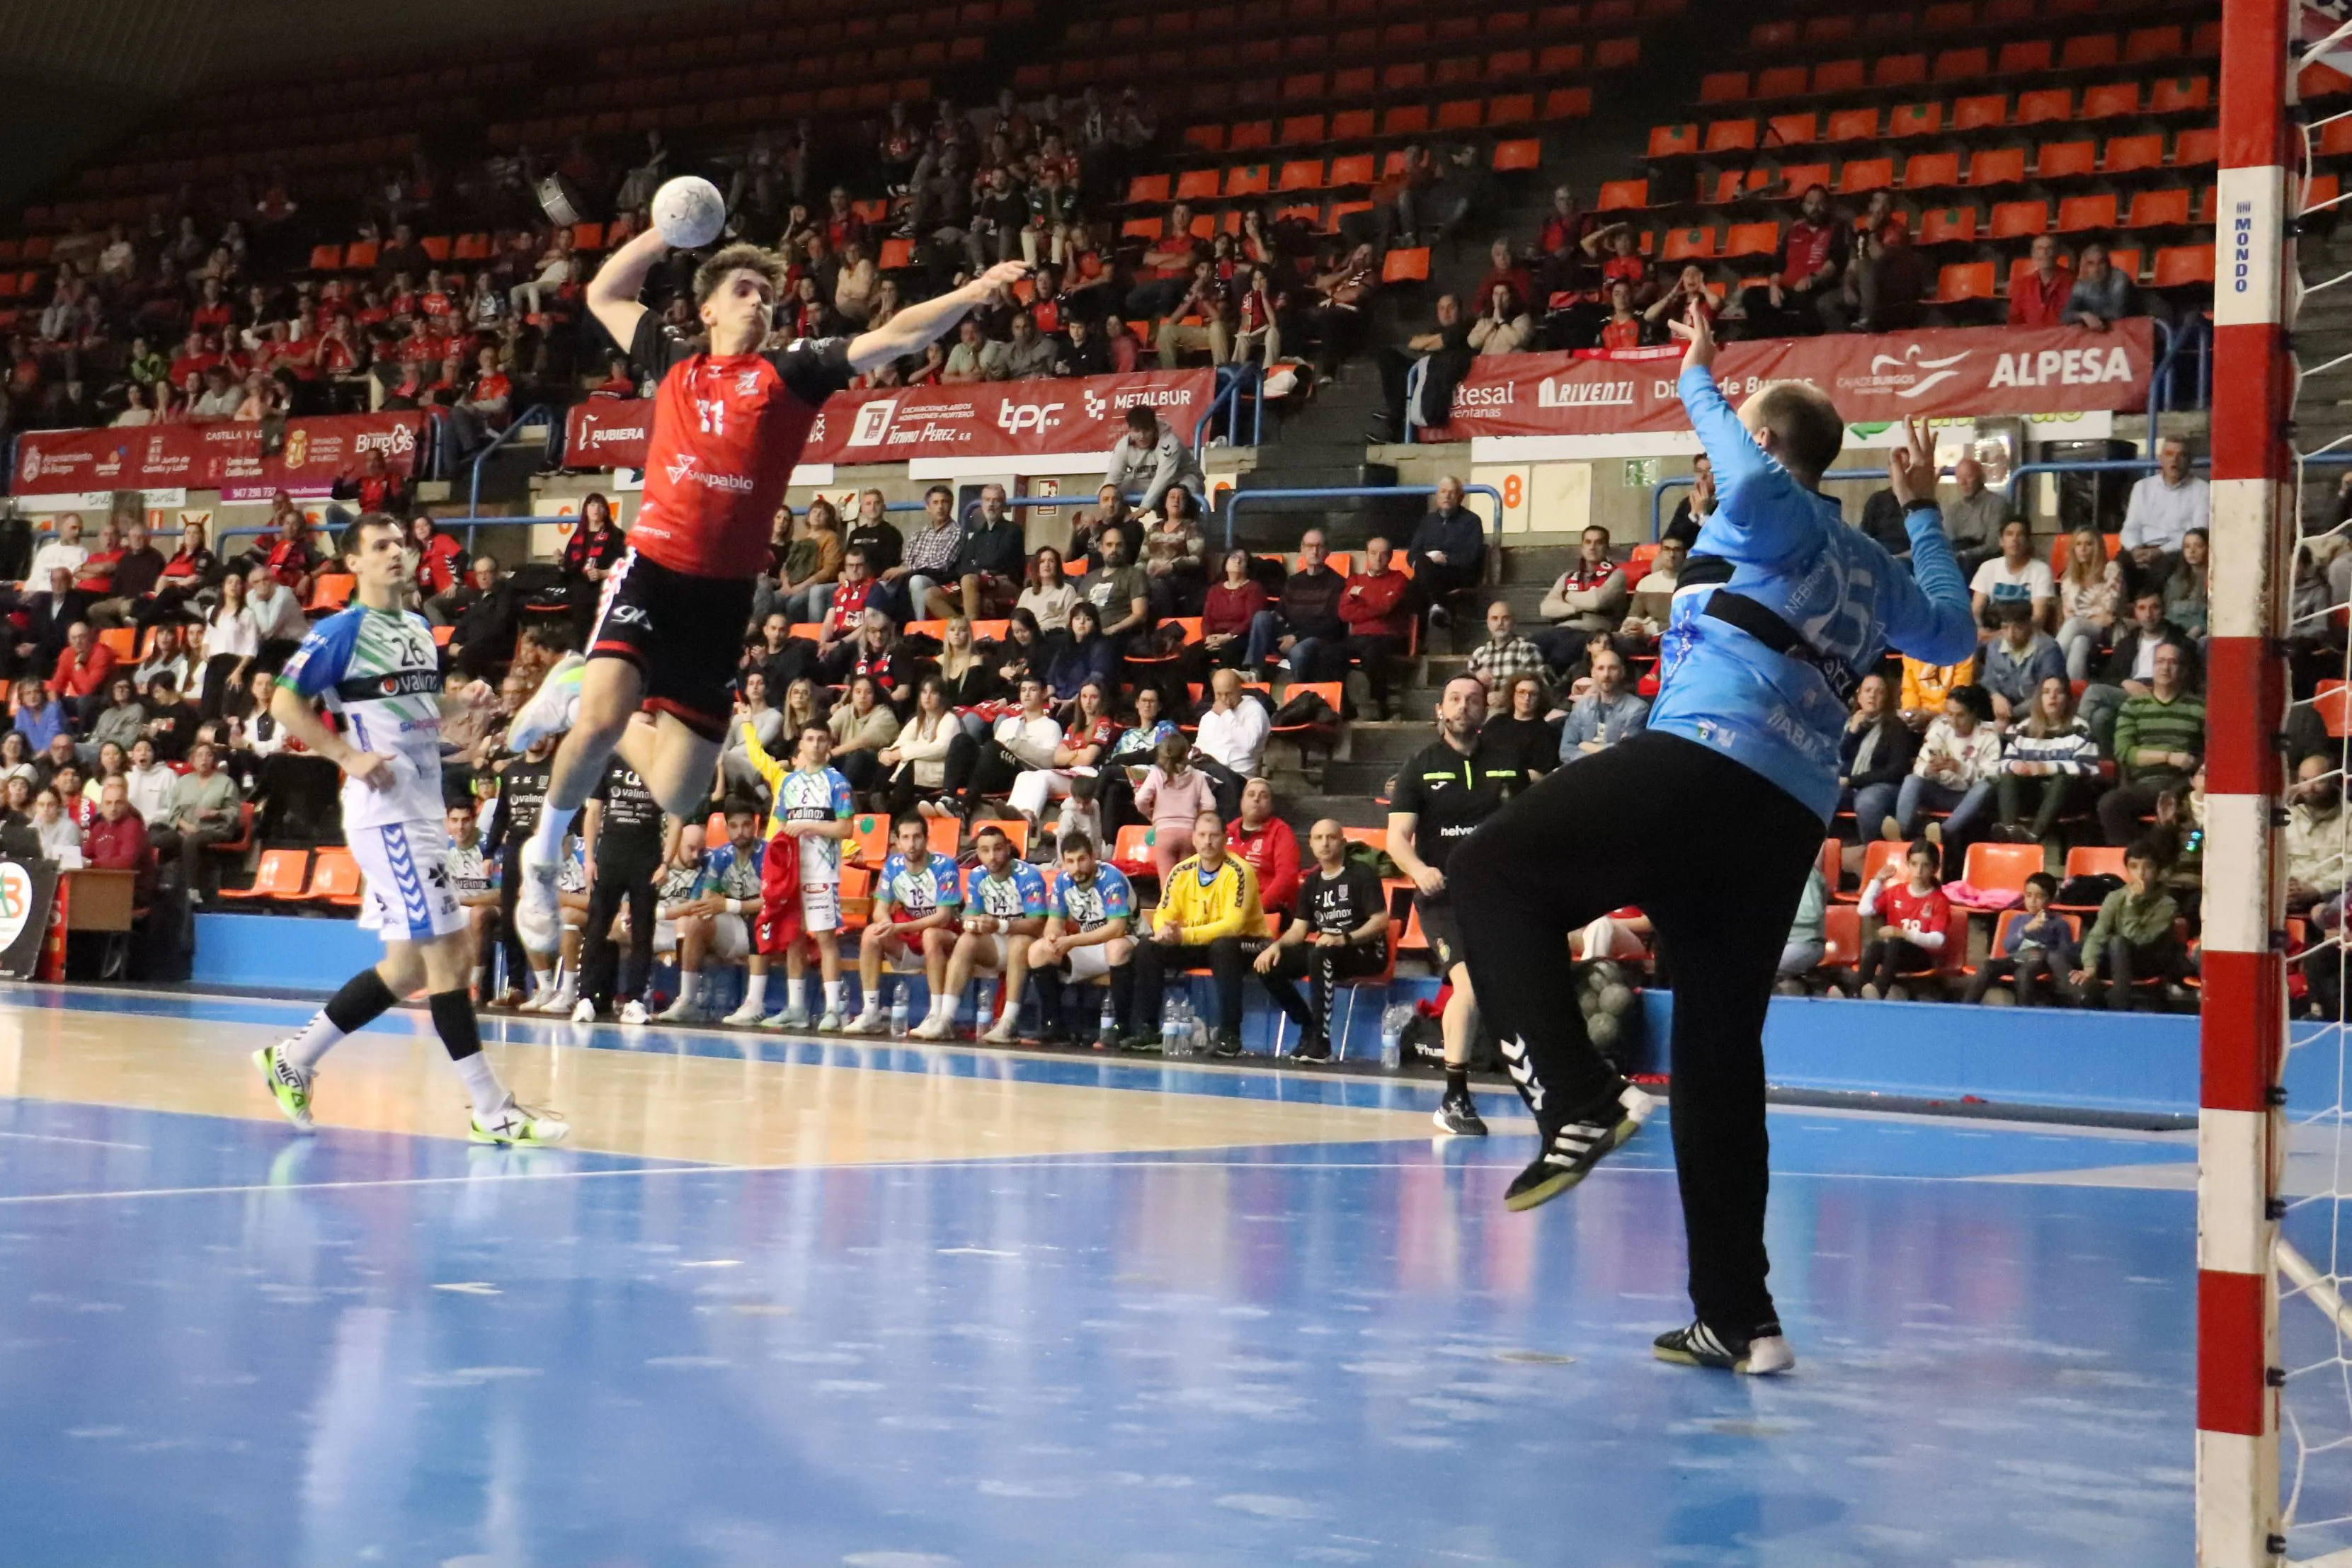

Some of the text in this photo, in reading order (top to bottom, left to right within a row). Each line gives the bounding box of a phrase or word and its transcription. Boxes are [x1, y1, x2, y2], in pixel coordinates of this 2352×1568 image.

[2234, 218, 2251, 293] MONDO
[1988, 346, 2132, 388] ALPESA
[1114, 389, 1191, 409] METALBUR
[206, 430, 241, 440] CASTILLA
[696, 399, 724, 436] 11
[1502, 474, 1523, 509] 8
[391, 636, 426, 667] 26
